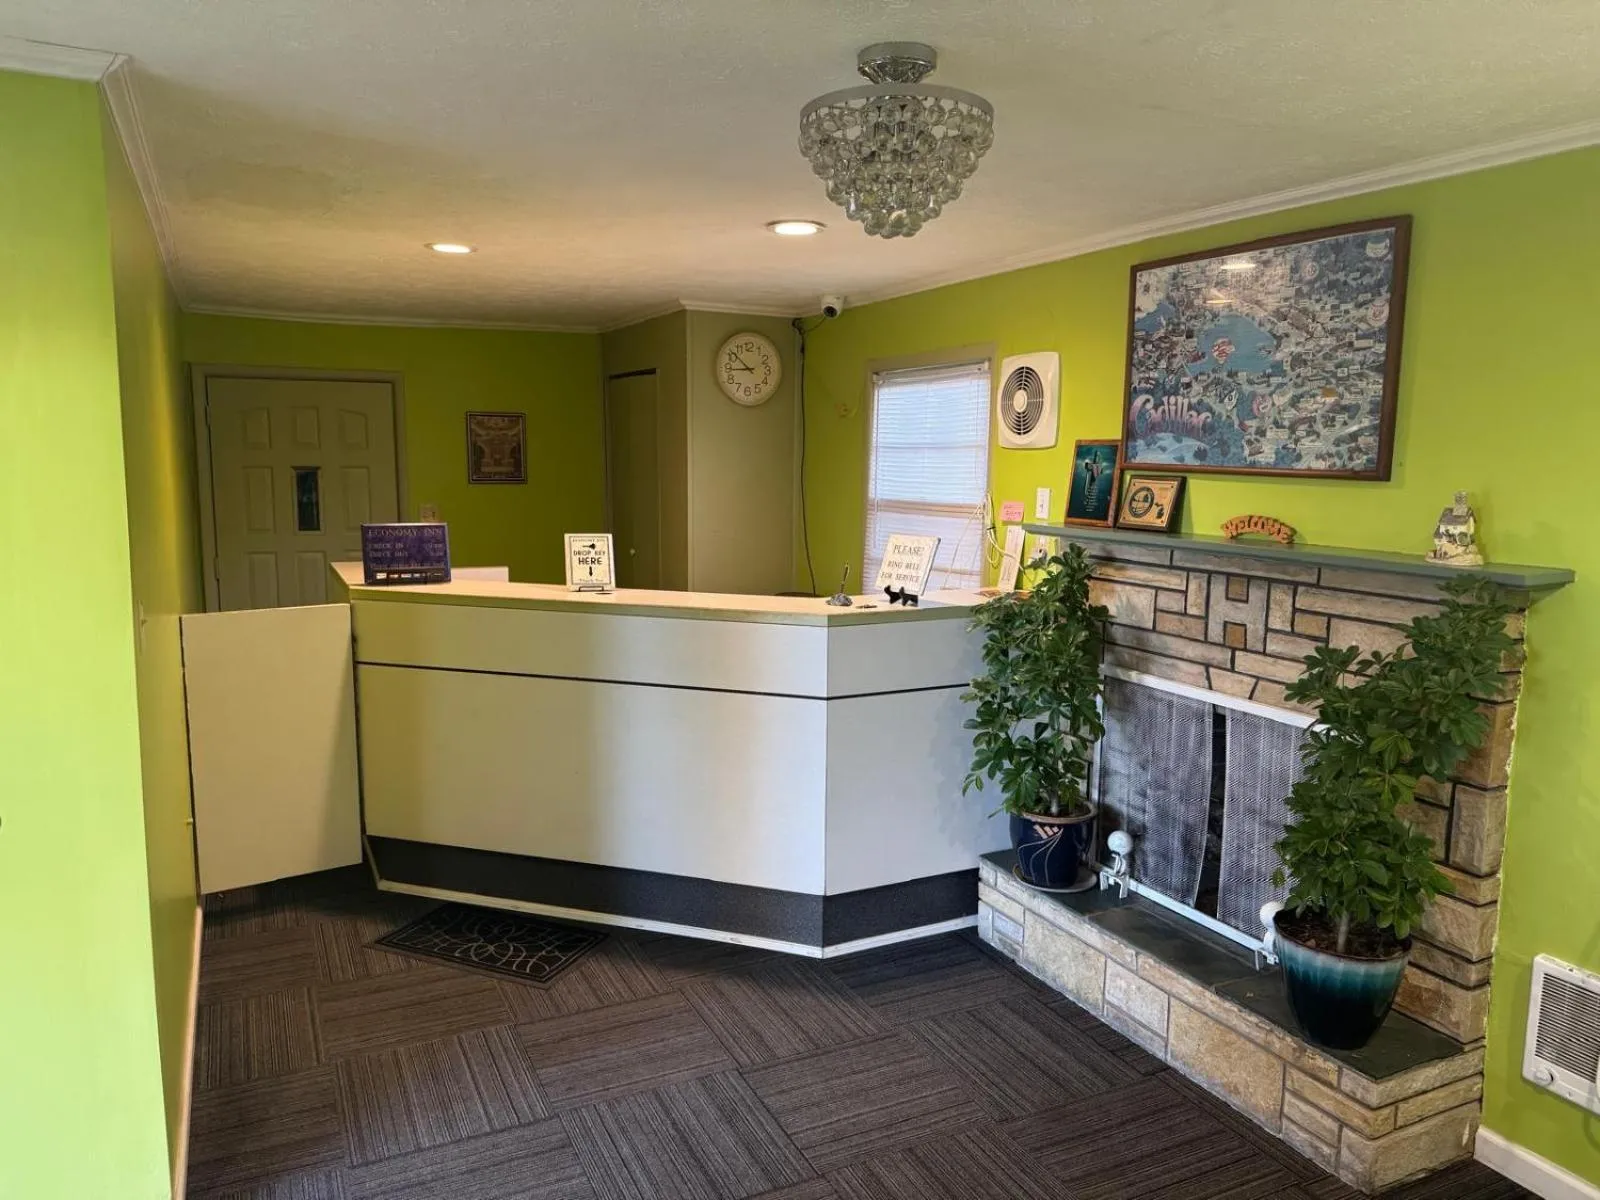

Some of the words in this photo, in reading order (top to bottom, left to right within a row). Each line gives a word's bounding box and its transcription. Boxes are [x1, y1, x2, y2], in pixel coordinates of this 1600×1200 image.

[735, 344, 744, 354] 11
[744, 342, 754, 352] 12
[761, 354, 769, 365] 2
[764, 365, 772, 376] 3
[727, 374, 735, 385] 8
[761, 376, 769, 387] 4
[735, 382, 742, 393] 7
[743, 386, 752, 397] 6
[754, 383, 762, 394] 5
[368, 527, 418, 537] ECONOMY
[578, 556, 603, 565] HERE
